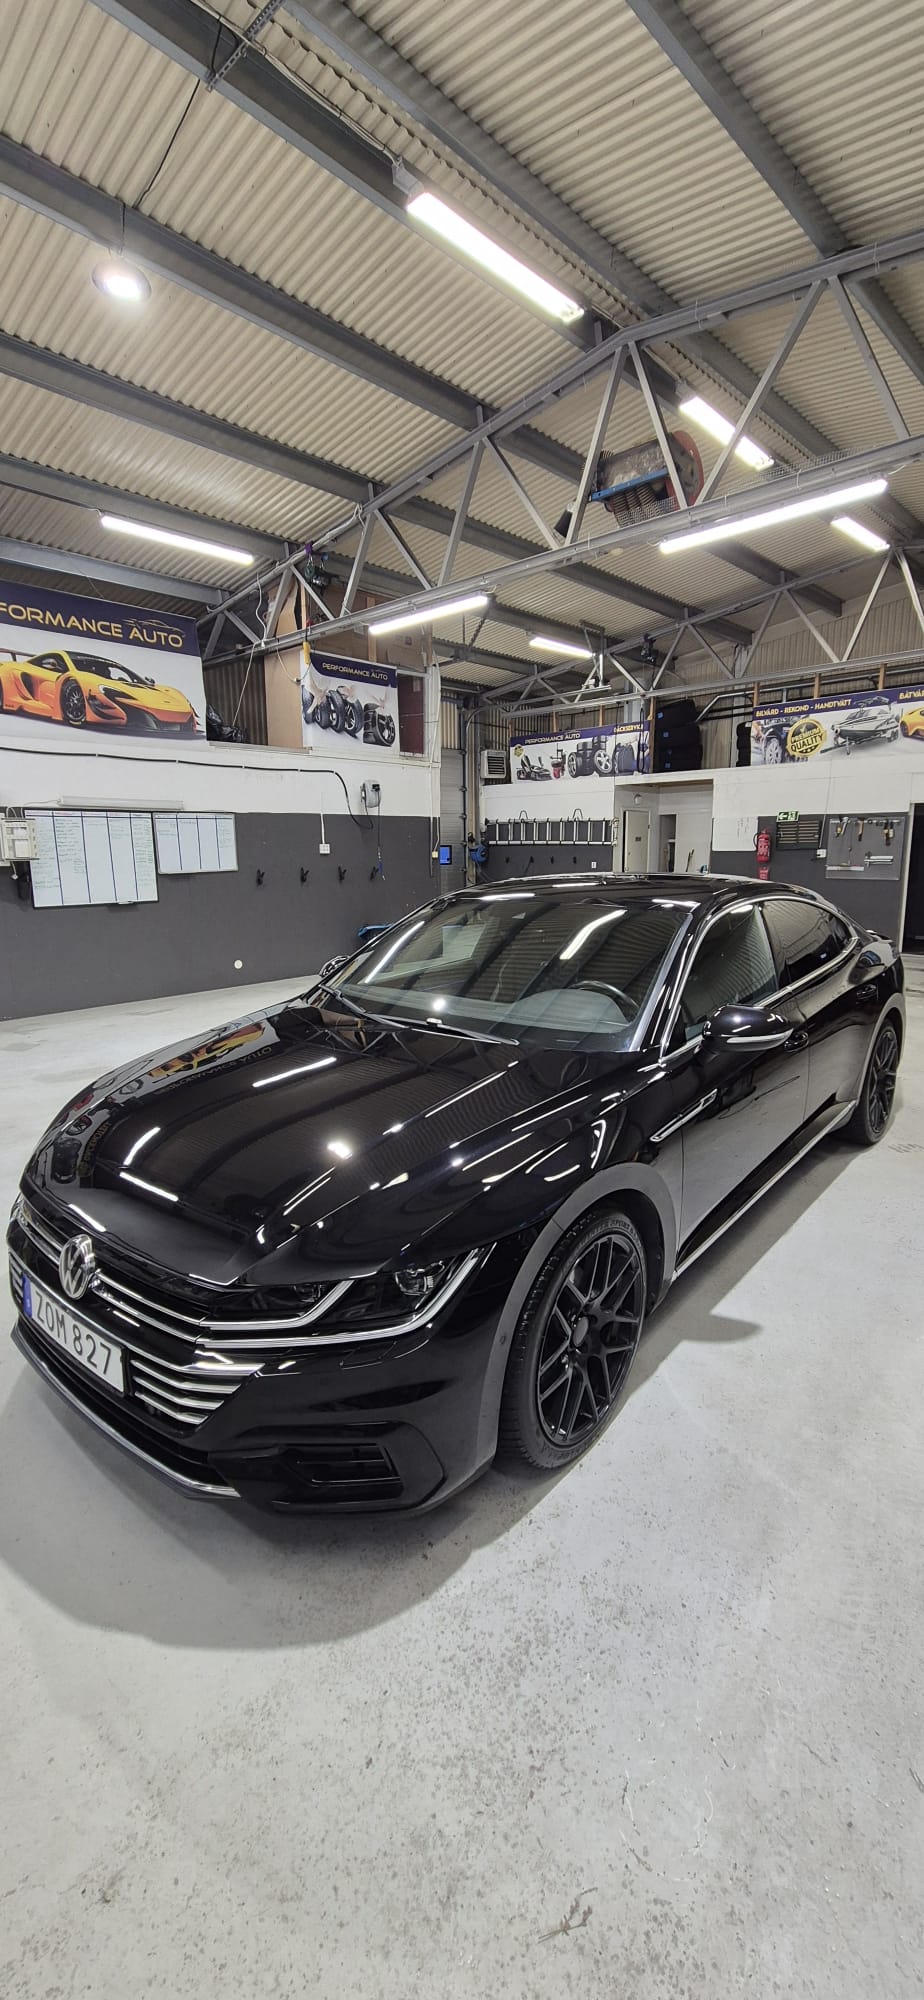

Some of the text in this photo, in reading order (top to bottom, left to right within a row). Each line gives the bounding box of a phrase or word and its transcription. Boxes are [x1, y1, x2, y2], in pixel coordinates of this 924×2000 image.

[129, 627, 184, 648] AUTO
[322, 662, 388, 680] PERFORMANCE AUTO
[524, 732, 581, 745] PERFORMANCE AUTO
[791, 727, 821, 744] PREMIUM
[791, 733, 823, 752] QUALITY
[36, 1291, 112, 1375] ZOM 827
